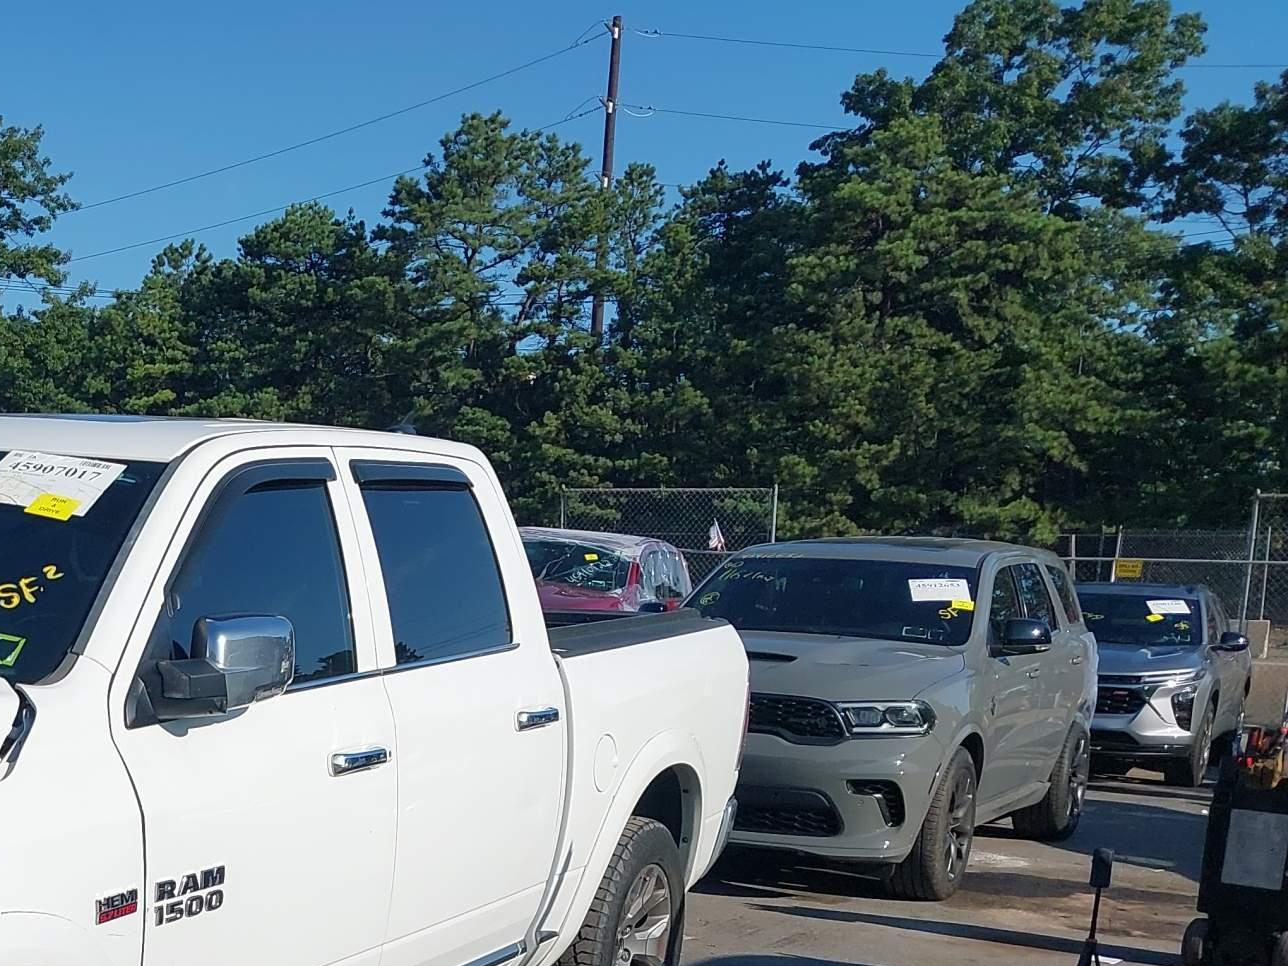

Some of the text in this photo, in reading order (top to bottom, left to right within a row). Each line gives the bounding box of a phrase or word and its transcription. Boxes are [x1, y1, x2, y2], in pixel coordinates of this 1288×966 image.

[9, 460, 103, 481] 45907017
[38, 506, 60, 514] DRIVE
[154, 865, 226, 903] RAM
[95, 888, 138, 913] HEMI
[154, 889, 225, 927] 1500
